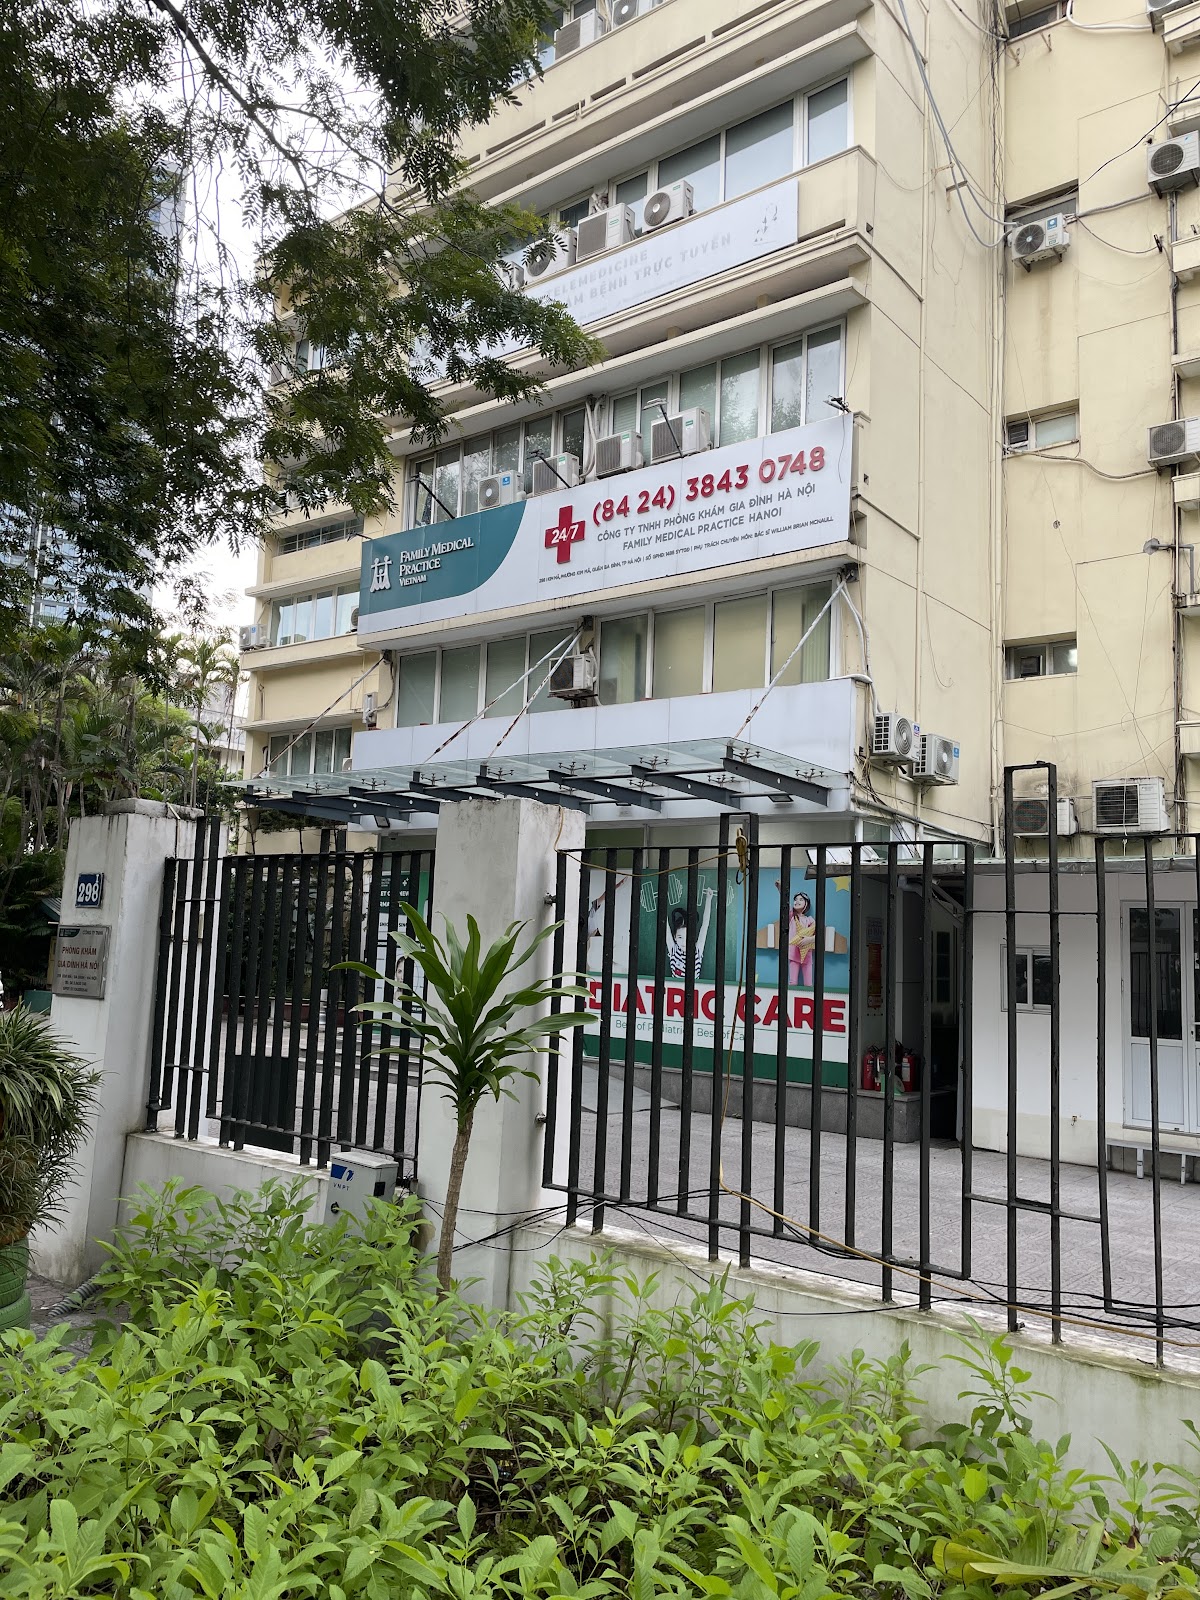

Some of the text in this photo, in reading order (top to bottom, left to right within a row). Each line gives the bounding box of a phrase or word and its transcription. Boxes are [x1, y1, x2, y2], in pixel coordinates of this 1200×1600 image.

[593, 446, 825, 527] (84 24) 3843 0748
[597, 482, 816, 542] CÔNG TY TNHH PHÒNG KHÁM GIA ĐÌNH HÀ NỘI
[551, 524, 579, 544] 24/7
[623, 507, 782, 550] FAMILY MEDICAL PRACTICE HANOI
[771, 525, 792, 534] WILLIAM
[793, 521, 809, 530] BRIAN
[400, 537, 474, 564] FAMILY MEDICAL
[399, 558, 441, 576] PRACTICE
[78, 882, 99, 902] 298
[584, 981, 846, 1033] DIATRIC CARE
[637, 1021, 645, 1031] of
[697, 1027, 714, 1038] Bes
[333, 1182, 350, 1191] VNPT
